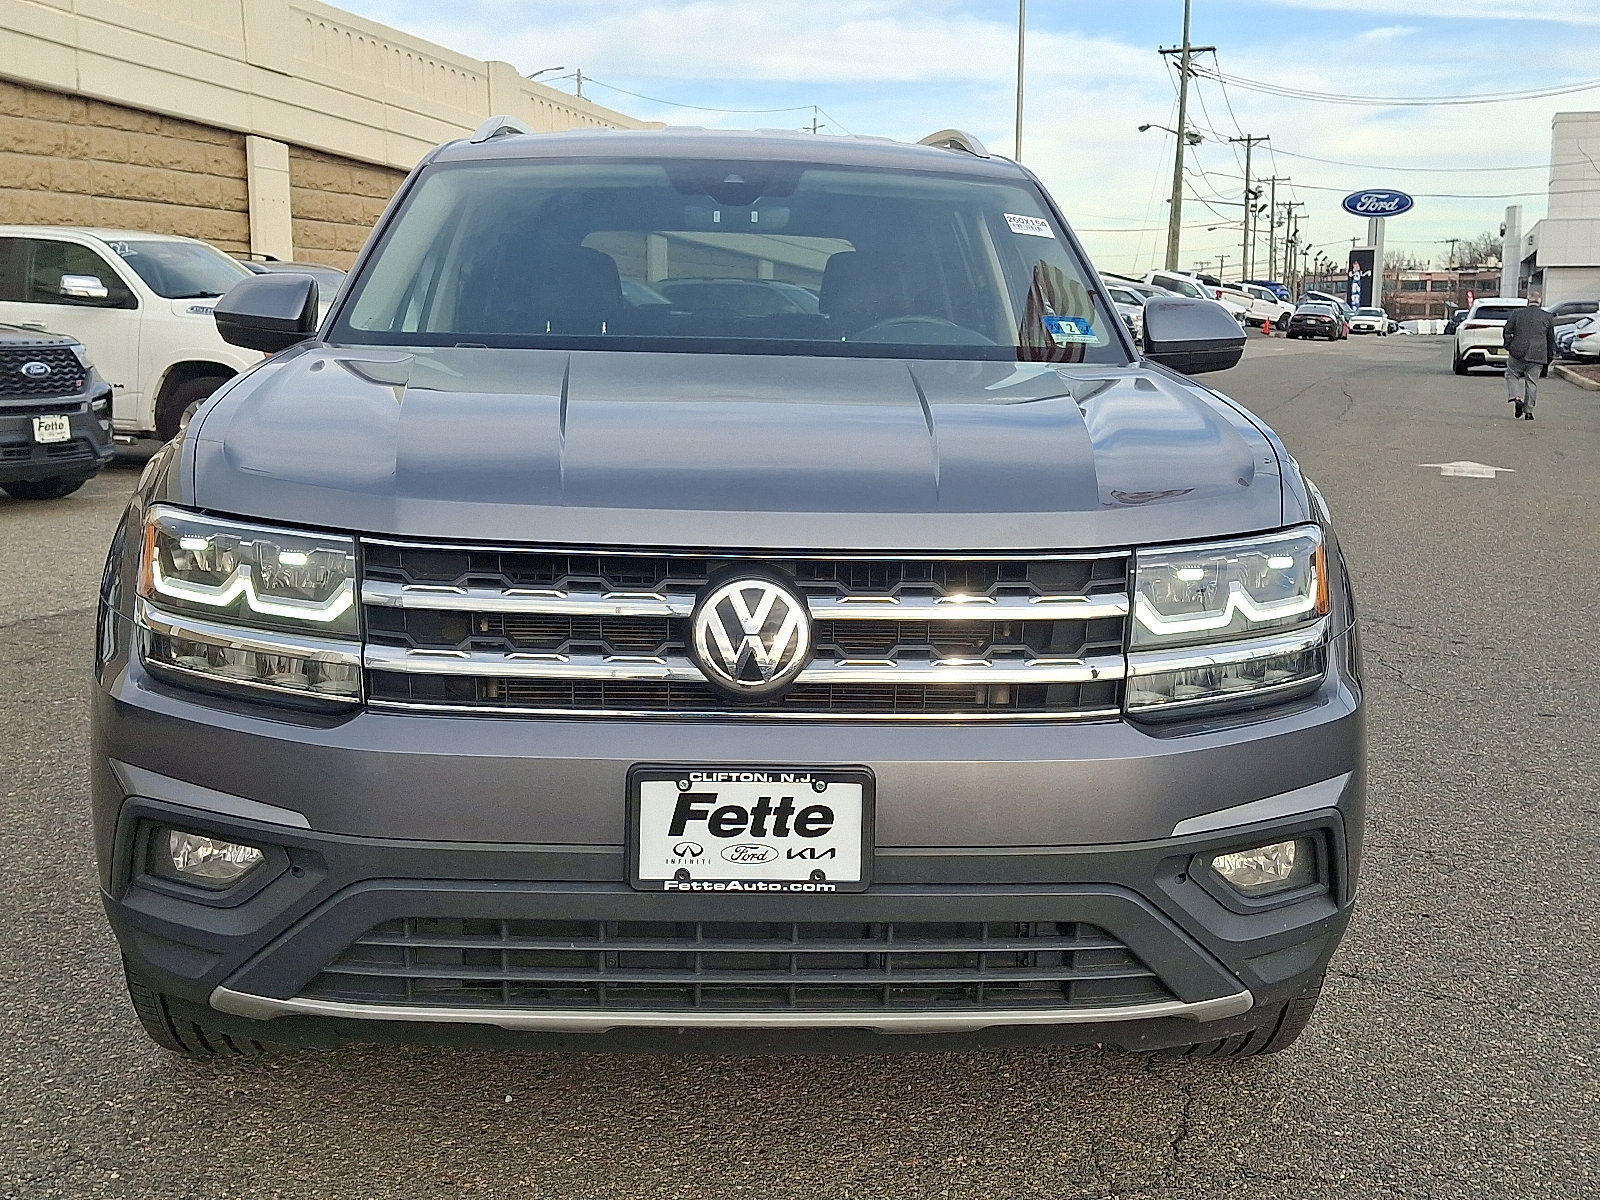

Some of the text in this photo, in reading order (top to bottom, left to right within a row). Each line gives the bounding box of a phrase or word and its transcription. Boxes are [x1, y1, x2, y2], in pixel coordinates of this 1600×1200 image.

[1356, 193, 1400, 212] Ford
[1065, 323, 1076, 333] 2
[689, 772, 816, 783] CLIFTON, N.J.
[667, 792, 835, 838] Fette
[730, 845, 769, 862] Ford
[663, 880, 836, 892] FetteAuto.com
